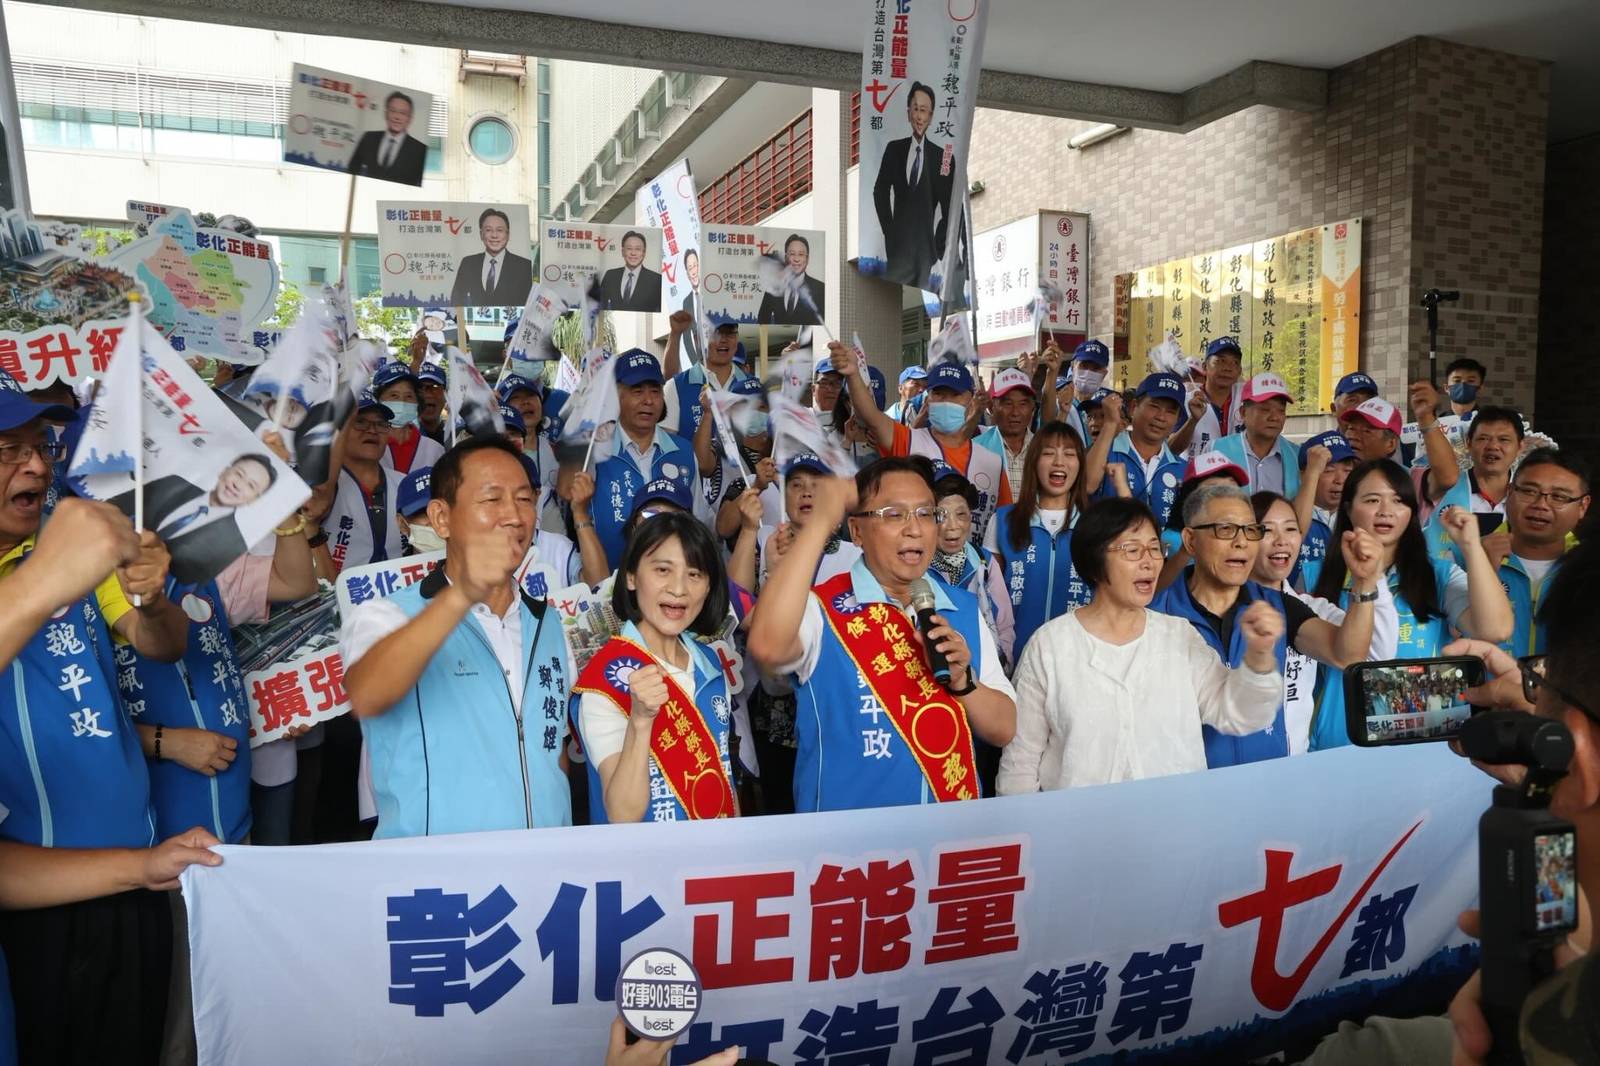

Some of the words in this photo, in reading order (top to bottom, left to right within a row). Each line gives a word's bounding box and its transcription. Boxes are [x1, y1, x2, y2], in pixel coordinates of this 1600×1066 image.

[196, 231, 271, 261] 彰化正能量
[1065, 243, 1081, 326] 臺灣銀行
[47, 622, 113, 738] 魏平政
[199, 625, 241, 728] 魏平政
[386, 843, 1026, 1018] 彰化正能量
[621, 982, 698, 1009] 好事903電台
[644, 959, 677, 976] best
[642, 1015, 675, 1032] best
